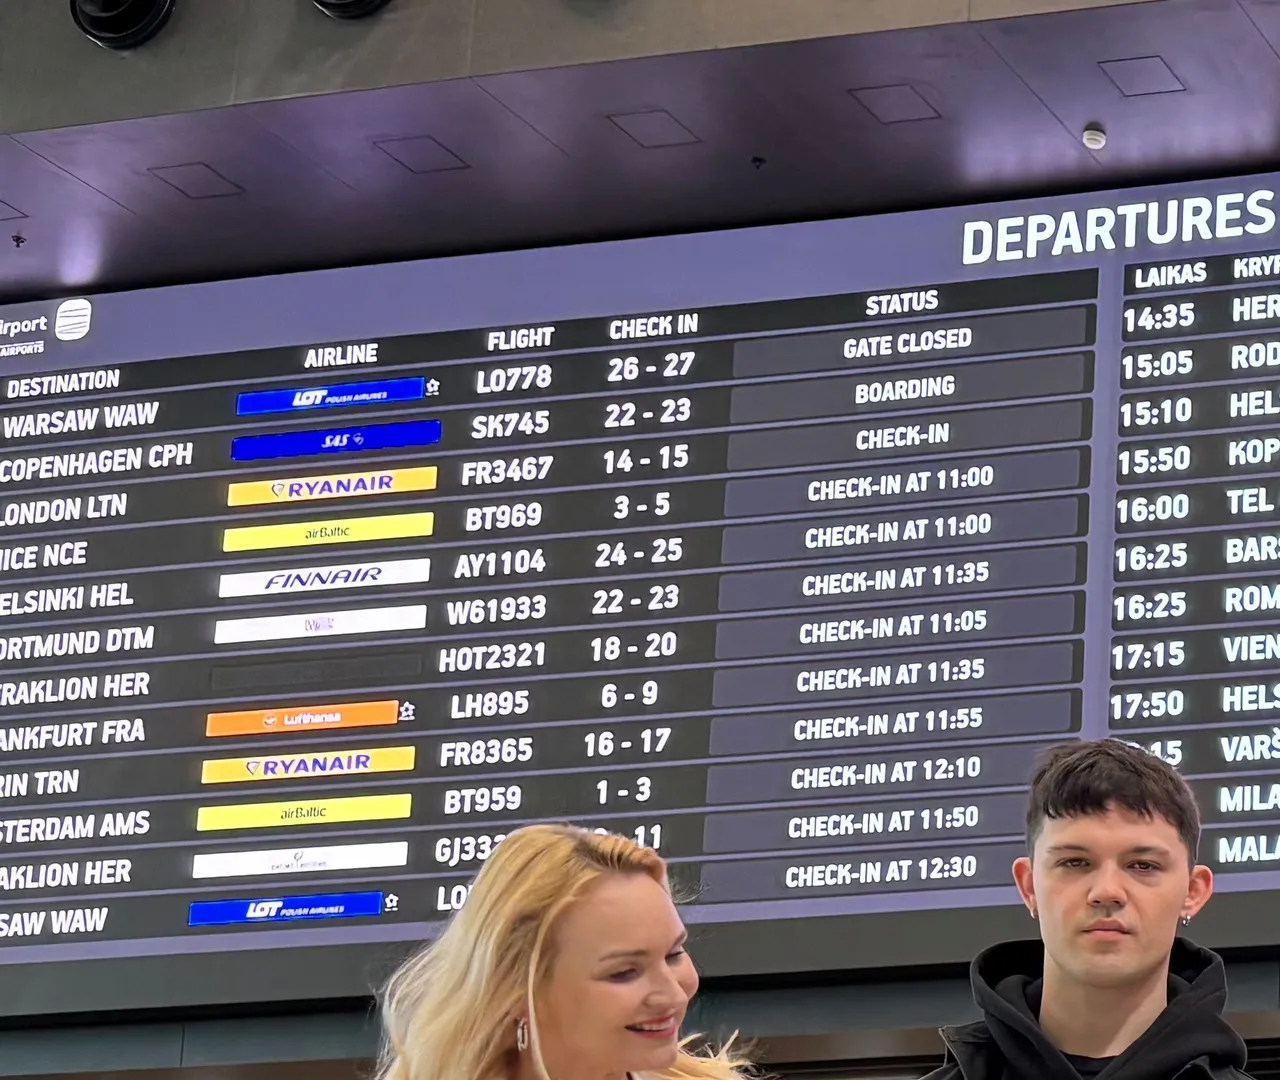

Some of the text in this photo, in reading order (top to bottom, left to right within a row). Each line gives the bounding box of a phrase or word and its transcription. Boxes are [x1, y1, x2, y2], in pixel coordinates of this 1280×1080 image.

[962, 189, 1276, 265] DEPARTURES
[1135, 262, 1207, 289] LAIKAS
[865, 289, 939, 316] STATUS
[1124, 302, 1195, 332] 14:35
[0, 316, 47, 337] irport
[487, 326, 556, 351] FLIGHT
[609, 313, 699, 340] CHECK IN
[304, 343, 379, 368] AIRLINE
[843, 327, 972, 359] GATE CLOSED
[476, 364, 552, 394] LO778
[607, 351, 696, 382] 26 27
[1122, 350, 1193, 380] 15:05
[7, 368, 120, 399] DESTINATION
[291, 389, 328, 407] LOT
[855, 375, 955, 404] BOARDING
[3, 401, 160, 439] WARSAW WAW
[471, 410, 550, 439] SK745
[604, 397, 691, 428] 22 23
[1120, 397, 1192, 427] 15:10
[321, 433, 350, 448] SAS
[856, 422, 950, 450] CHECK-IN
[0, 442, 193, 483] COPENHAGEN CPH
[461, 455, 554, 486] FR3467
[1118, 445, 1191, 475] 15:50
[288, 475, 393, 497] RYANAIR
[808, 465, 994, 502] CHECK-IN AT 11:00
[86, 492, 128, 519] LTN
[1117, 493, 1189, 524] 16:00
[1226, 487, 1275, 514] TEL
[465, 502, 542, 531] BT969
[805, 513, 992, 549] CHECK-IN AT 11:00
[42, 541, 88, 567] NCE
[454, 548, 546, 579] AY1104
[1115, 542, 1188, 572] 16:25
[265, 566, 382, 589] FINNAIR
[90, 582, 134, 608] HEL
[1113, 591, 1186, 621] 16:25
[446, 594, 547, 626] W61933
[106, 625, 155, 652] DTM
[438, 641, 545, 673] HOT2321
[1112, 640, 1185, 670] 17:15
[103, 672, 150, 698] HER
[451, 690, 529, 719] LH895
[1110, 690, 1184, 720] 17:50
[101, 718, 145, 744] FRA
[263, 754, 371, 775] RYANAIR
[34, 769, 80, 795] TRN
[99, 810, 150, 837] AMS
[84, 859, 132, 885] HER
[785, 855, 977, 888] CHECK-IN AT 12:30
[50, 907, 109, 934] WAW
